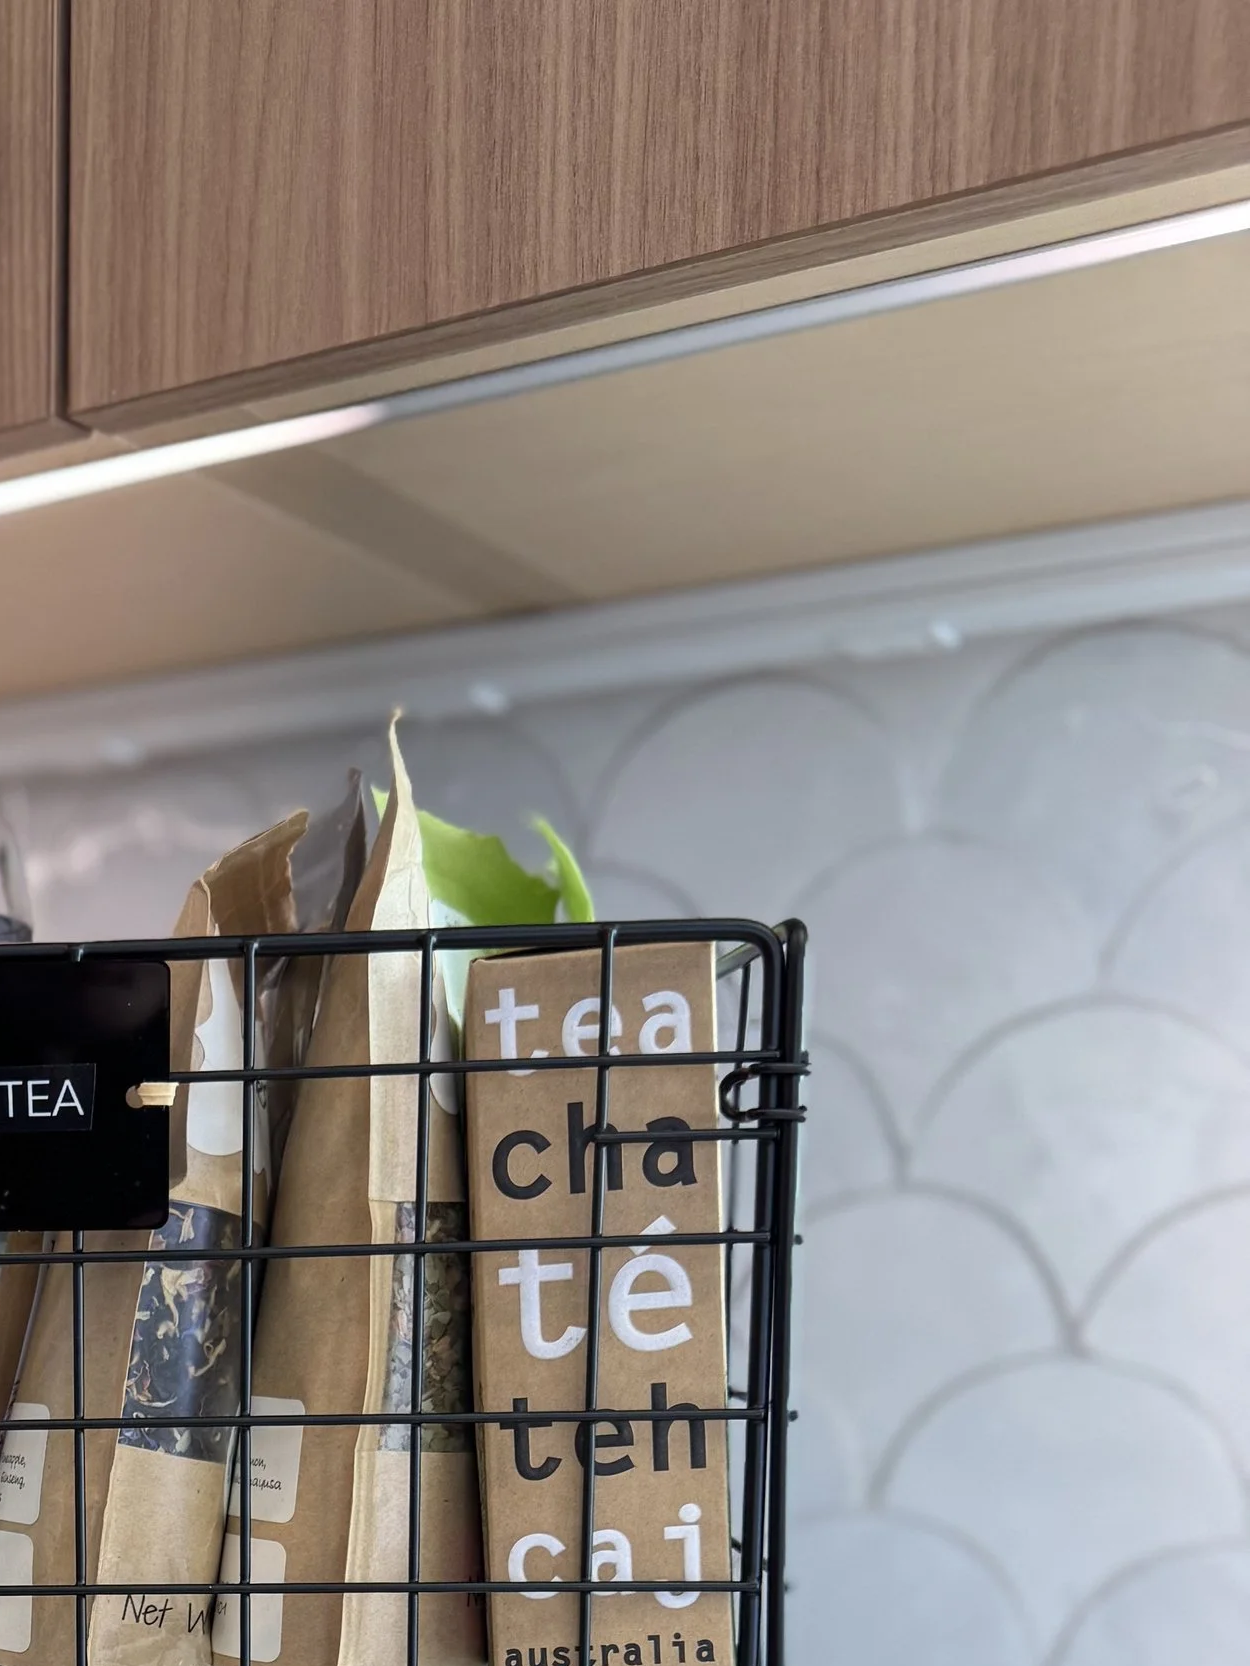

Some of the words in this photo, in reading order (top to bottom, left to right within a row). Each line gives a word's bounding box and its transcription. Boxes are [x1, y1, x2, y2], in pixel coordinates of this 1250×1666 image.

[485, 988, 692, 1077] tea
[492, 1102, 698, 1200] cha
[499, 1215, 693, 1359] té
[500, 1382, 706, 1481] teh
[507, 1503, 702, 1609] caj
[121, 1593, 173, 1628] Net
